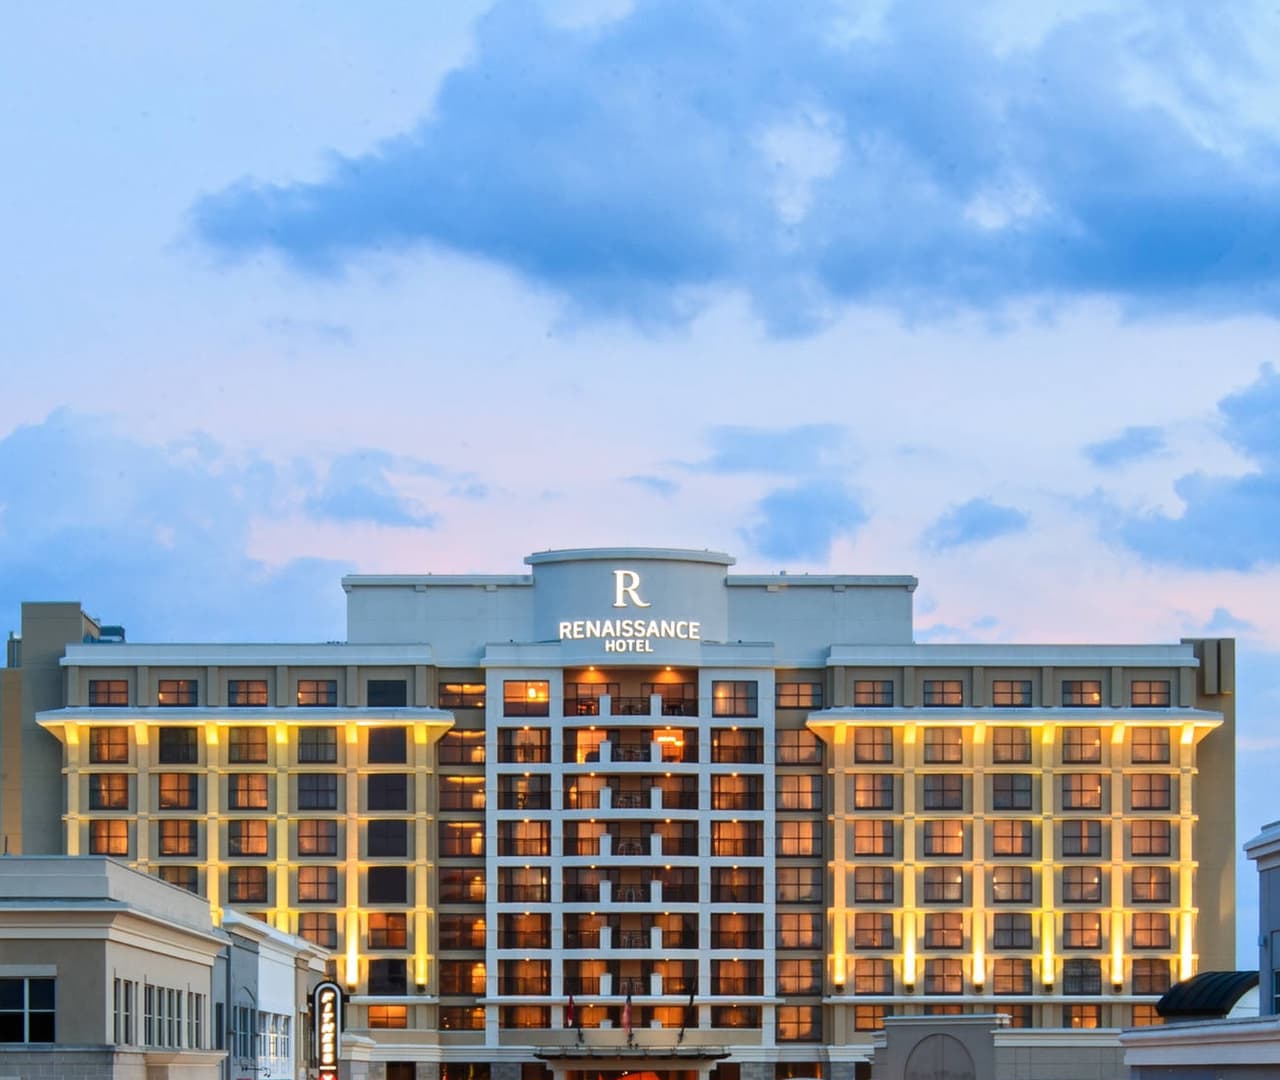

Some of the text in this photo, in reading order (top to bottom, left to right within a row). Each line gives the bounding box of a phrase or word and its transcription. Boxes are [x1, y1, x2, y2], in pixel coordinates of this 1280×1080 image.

[613, 570, 651, 607] R
[559, 619, 701, 640] RENAISSANCE
[605, 640, 654, 652] HOTEL
